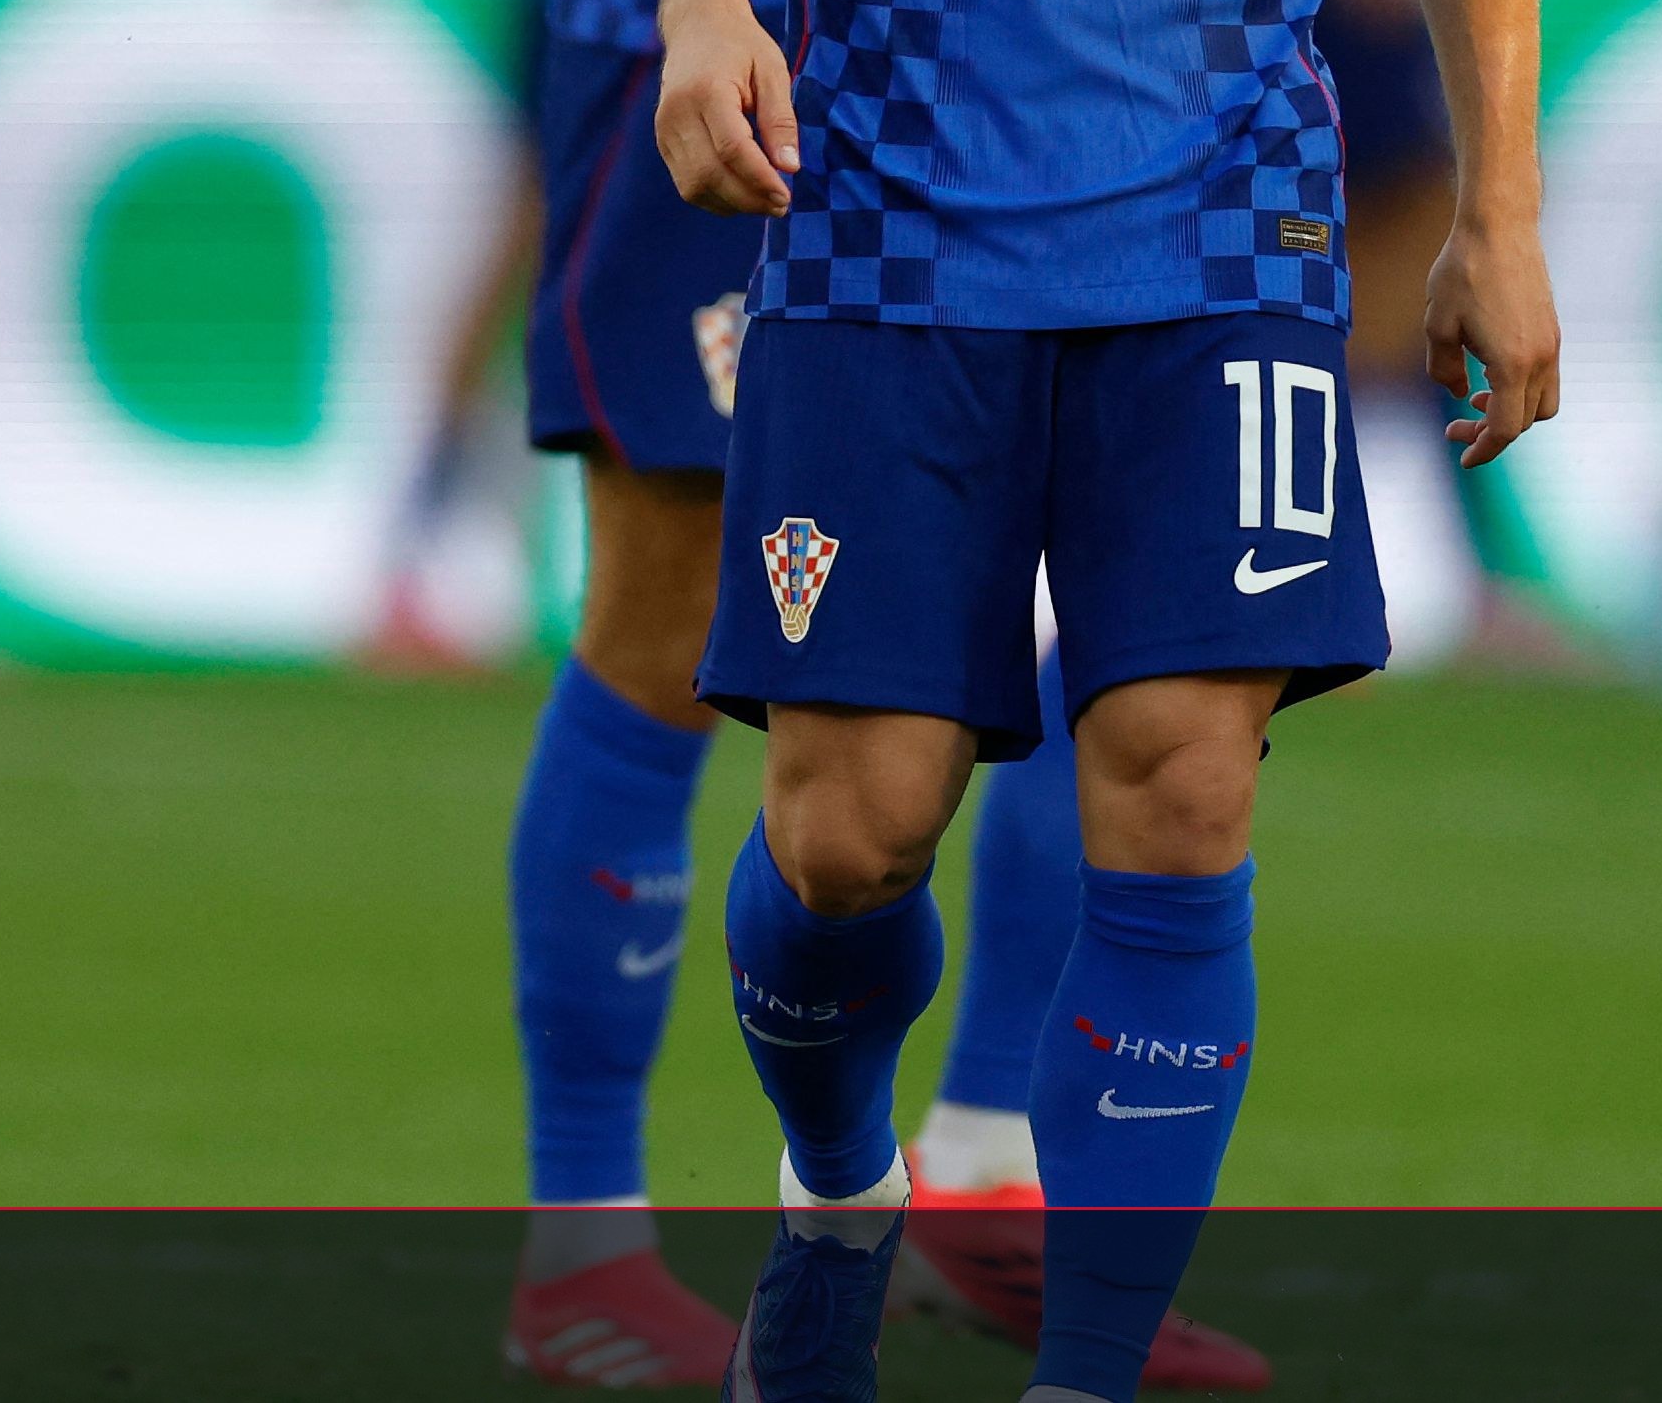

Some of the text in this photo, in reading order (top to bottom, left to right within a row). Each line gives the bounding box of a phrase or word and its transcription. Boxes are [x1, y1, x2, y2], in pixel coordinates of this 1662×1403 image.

[1224, 360, 1337, 539] 10
[744, 971, 838, 1021] HNS
[1114, 1032, 1218, 1069] HNS
